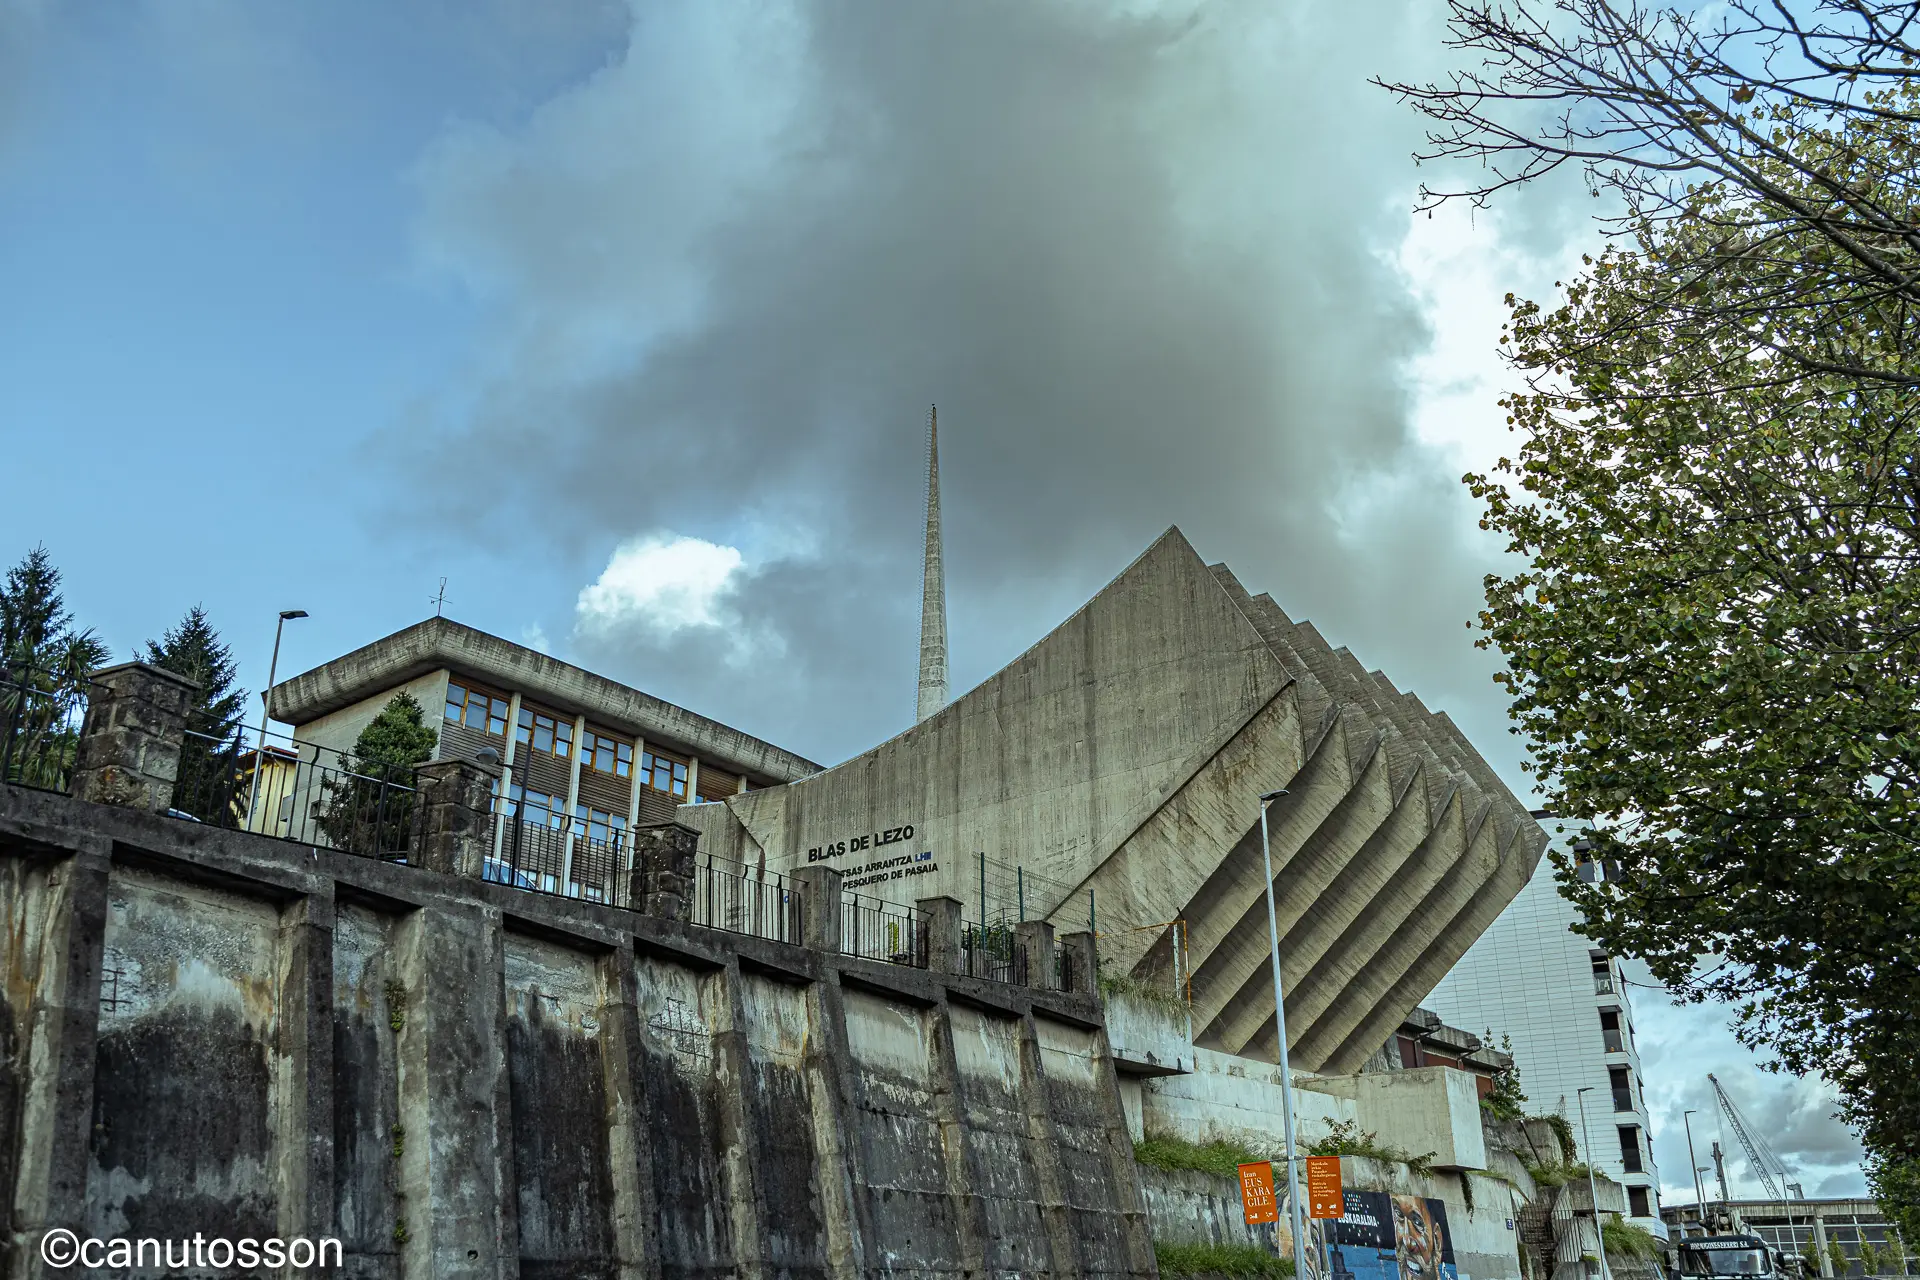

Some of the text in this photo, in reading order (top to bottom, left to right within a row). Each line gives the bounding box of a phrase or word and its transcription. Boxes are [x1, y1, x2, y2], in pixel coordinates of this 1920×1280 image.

[808, 825, 914, 862] BLAS DE LEZO
[864, 854, 913, 873] ARRANTZA
[842, 863, 939, 890] PESQUERO DE PASAIA
[1244, 1177, 1263, 1188] EUS
[1246, 1186, 1271, 1198] KARA
[1247, 1196, 1272, 1207] GILE.
